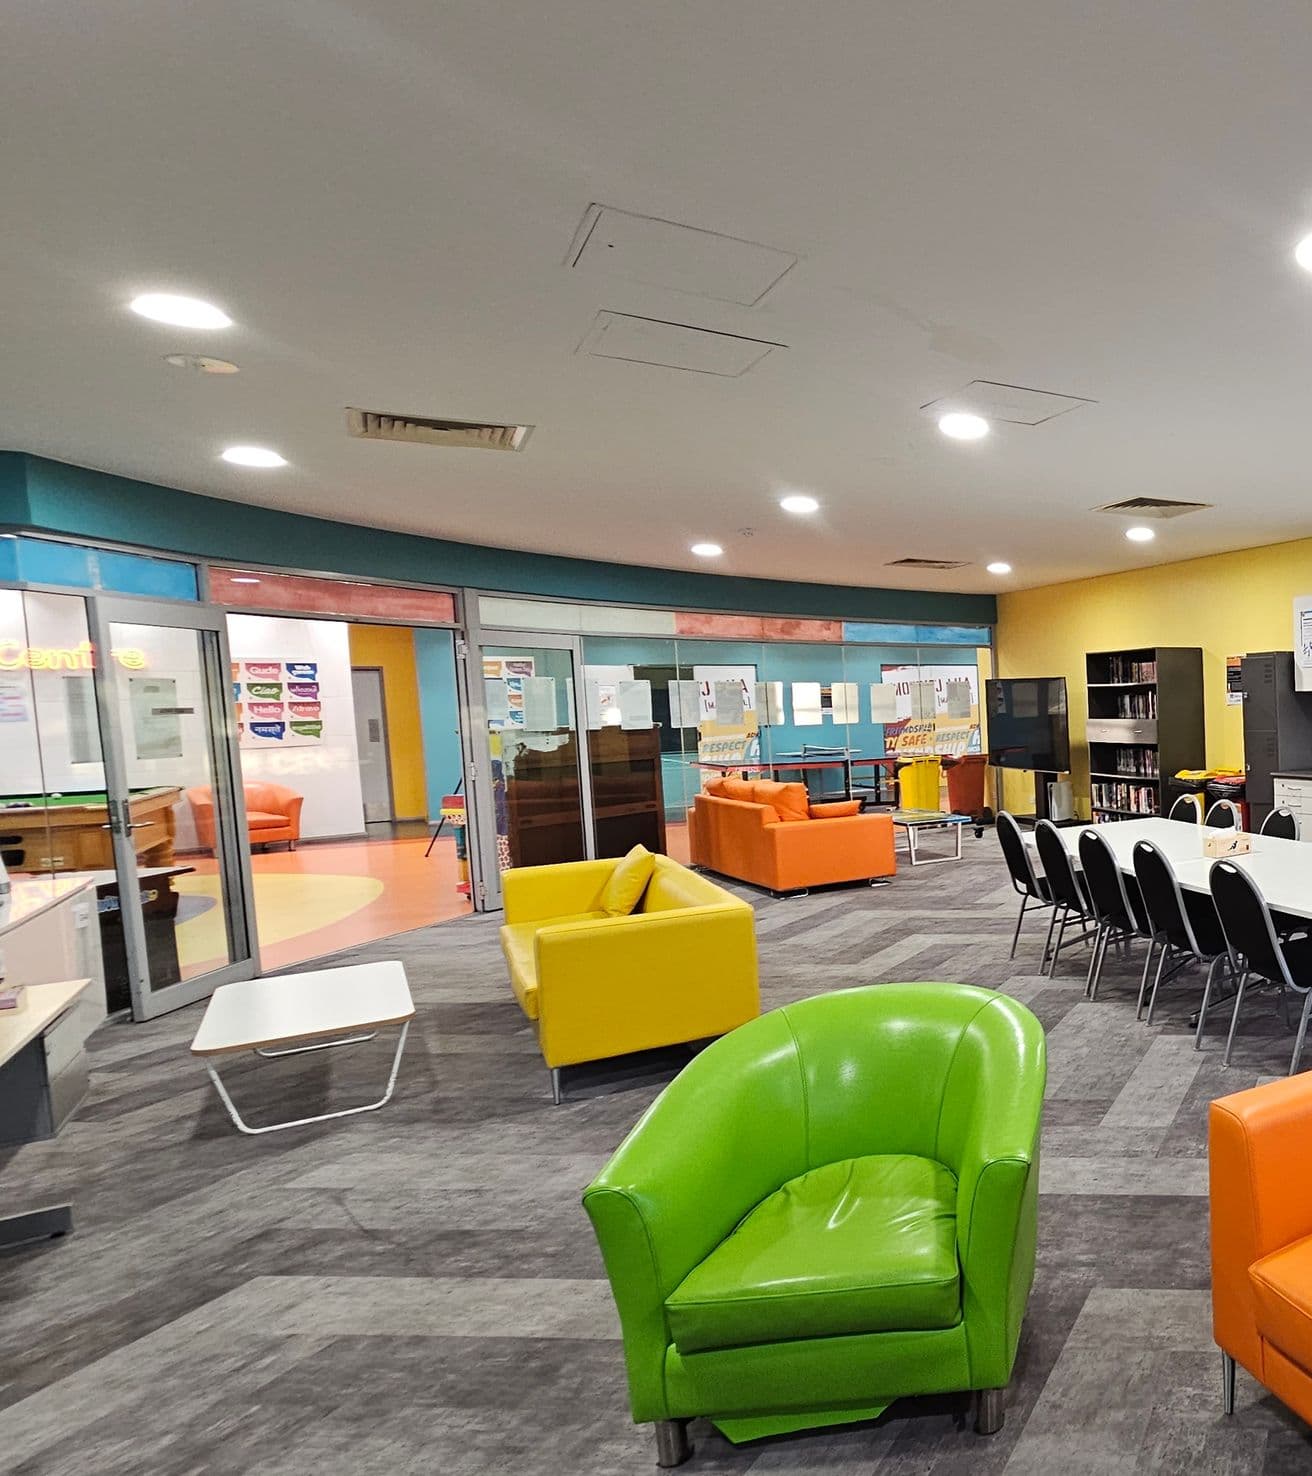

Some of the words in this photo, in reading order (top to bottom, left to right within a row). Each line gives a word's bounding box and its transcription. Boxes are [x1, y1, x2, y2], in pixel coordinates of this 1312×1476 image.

[0, 640, 147, 671] Cente
[251, 686, 279, 695] Ciao
[253, 705, 281, 713] Hello
[901, 733, 927, 747] SAFE
[936, 731, 969, 742] RESPECT
[703, 740, 747, 753] RESPECT
